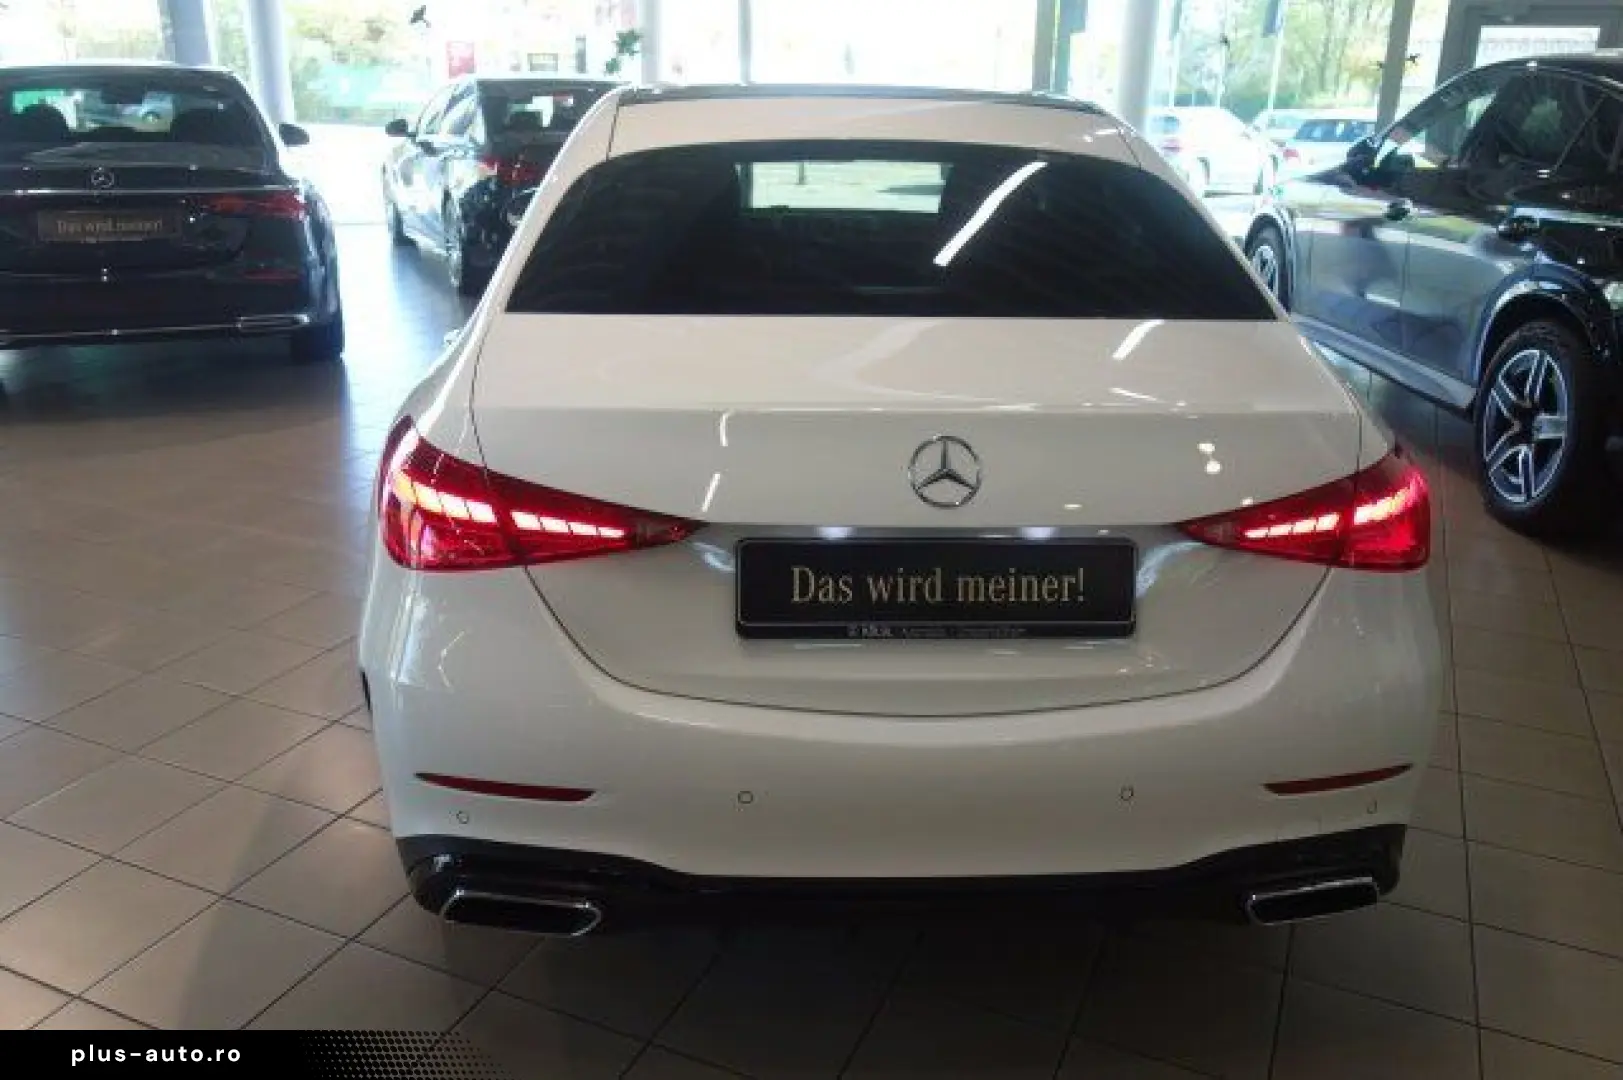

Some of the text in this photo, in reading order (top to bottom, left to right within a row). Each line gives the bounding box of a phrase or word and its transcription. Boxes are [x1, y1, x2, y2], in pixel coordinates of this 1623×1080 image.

[792, 567, 1085, 602] Das wird meiner!
